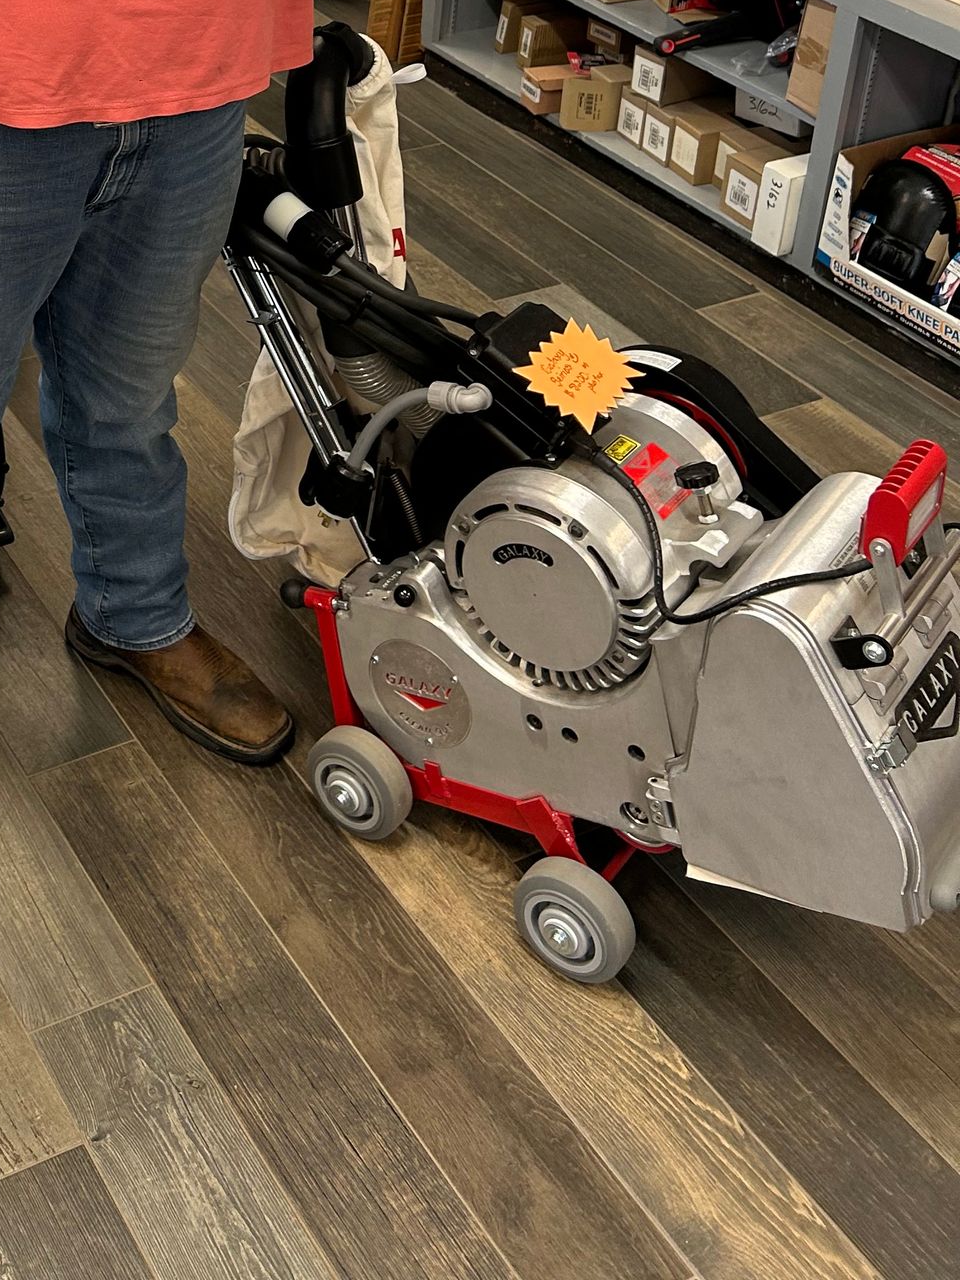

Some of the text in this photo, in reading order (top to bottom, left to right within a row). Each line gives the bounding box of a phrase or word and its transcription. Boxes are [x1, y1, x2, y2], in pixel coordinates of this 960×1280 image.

[766, 178, 783, 210] 3162
[833, 260, 960, 343] SUPER-SOFT KNEE PA
[849, 286, 871, 301] COMFY
[877, 304, 894, 316] SOFT
[900, 316, 930, 338] DURABLE
[936, 338, 960, 354] WASHA
[498, 545, 548, 562] GALAXY
[386, 672, 452, 700] GALAXY
[903, 645, 959, 733] GALAXY
